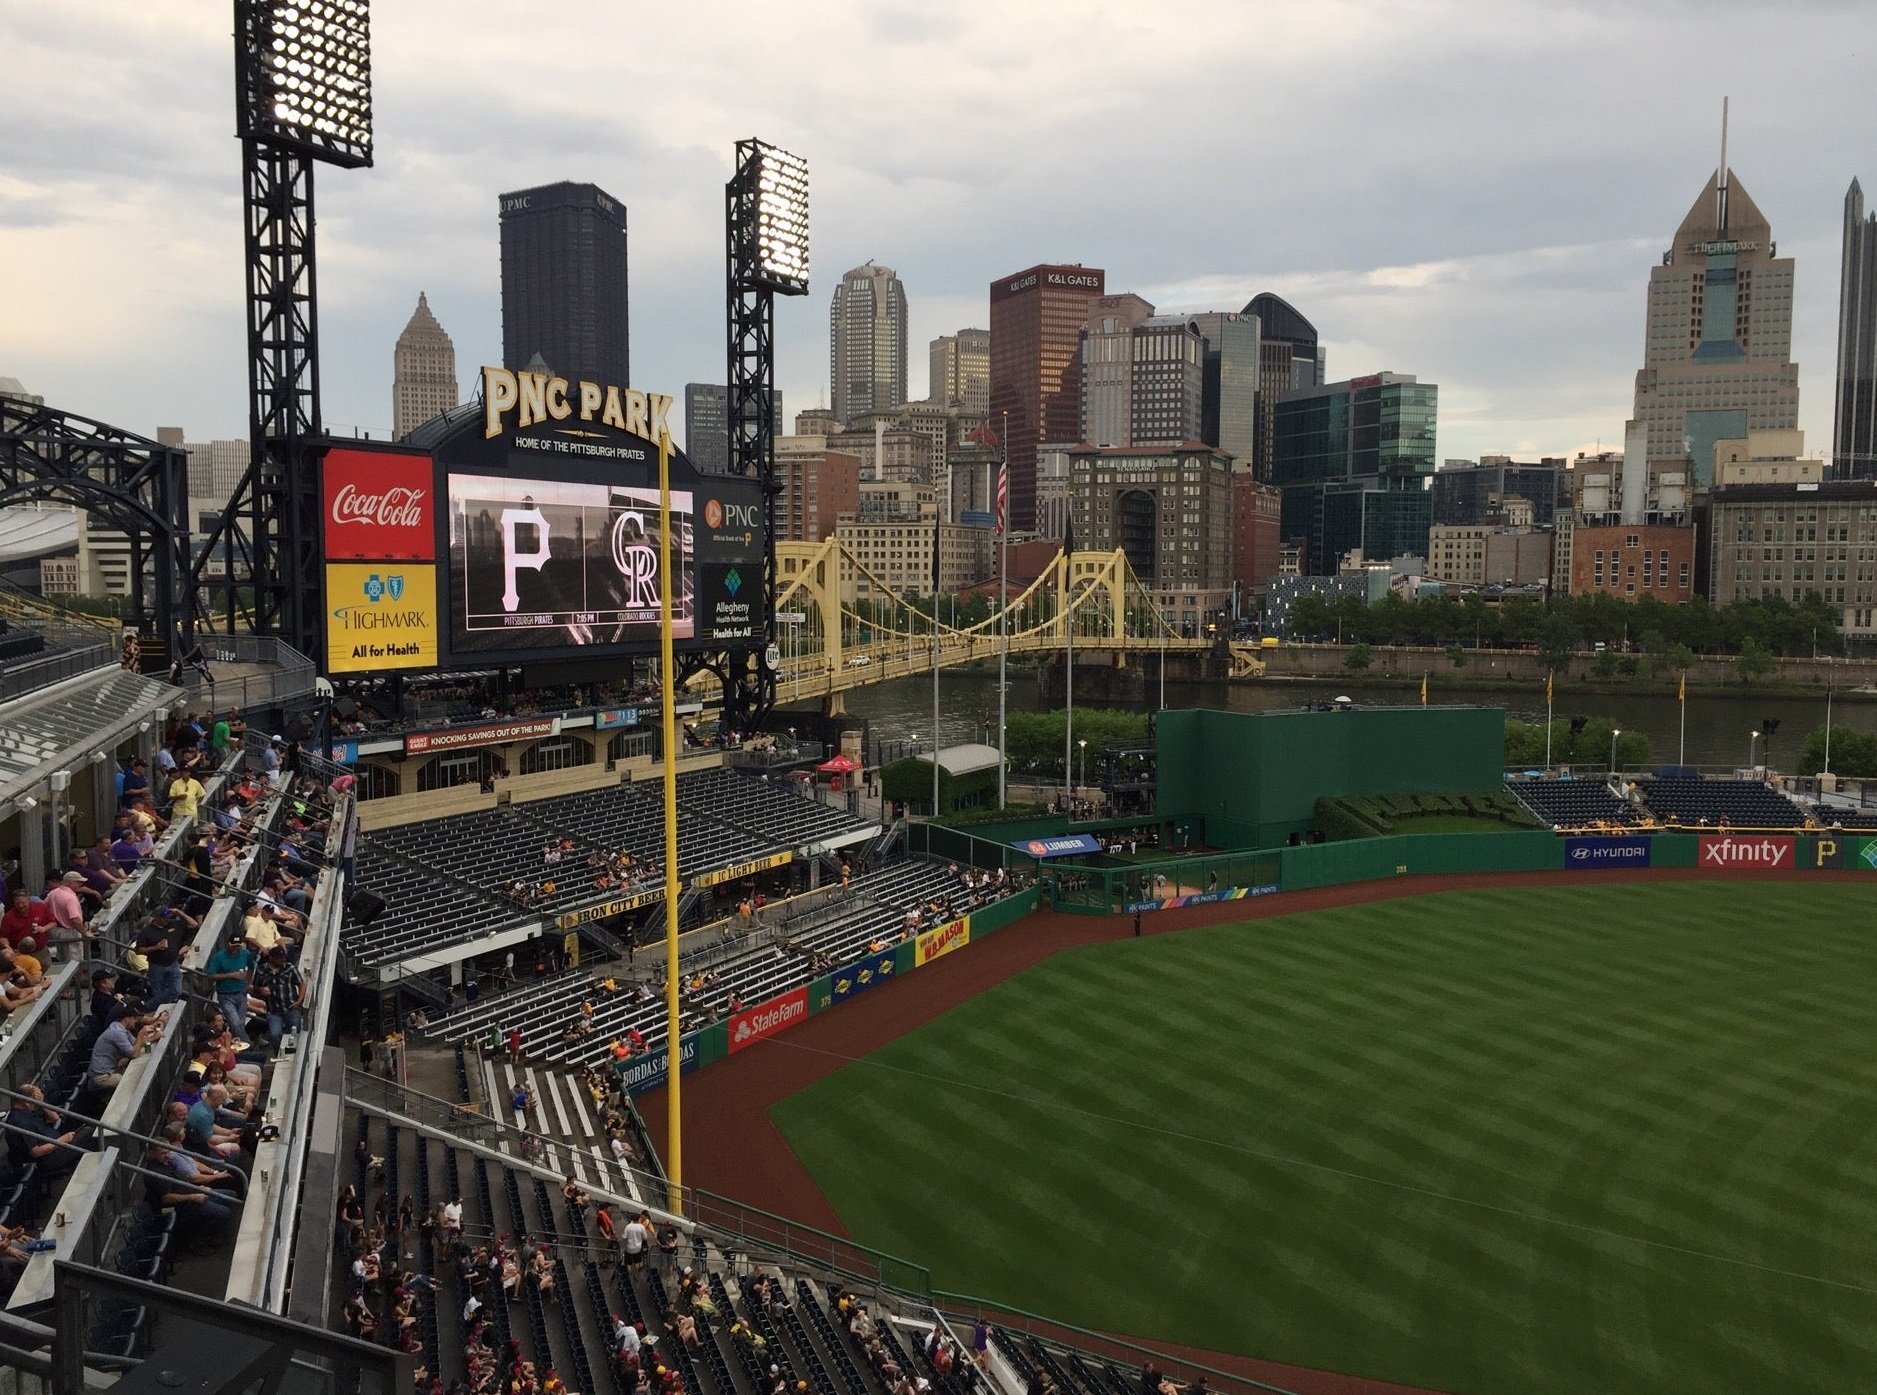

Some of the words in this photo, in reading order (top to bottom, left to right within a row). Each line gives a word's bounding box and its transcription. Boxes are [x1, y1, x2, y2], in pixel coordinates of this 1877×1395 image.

[500, 196, 531, 212] UPMC
[1048, 274, 1066, 284] K&L
[1067, 275, 1099, 287] GATES
[482, 366, 572, 439] PNC
[580, 381, 676, 457] PARK
[515, 437, 540, 449] HOME
[541, 439, 551, 450] OF
[553, 441, 569, 452] THE
[570, 442, 616, 457] PITTSBURGH
[617, 448, 645, 460] PIRATES
[332, 484, 425, 526] Coca-Cola
[723, 504, 759, 527] PNC
[617, 612, 639, 621] COLORADO
[639, 611, 656, 620] ROCKIES
[716, 602, 750, 615] Allegheny
[504, 616, 534, 626] PITTSBURGH
[534, 615, 553, 625] PIRATES
[576, 613, 586, 623] 7:05
[587, 613, 595, 622] PM
[713, 628, 733, 639] Health
[742, 627, 752, 637] All
[352, 645, 367, 658] All
[369, 644, 384, 657] for
[387, 642, 420, 656] Health
[767, 651, 779, 663] Lite
[431, 734, 467, 745] KNOCKING
[468, 730, 495, 741] SAVINGS
[496, 728, 510, 737] OUT
[511, 727, 520, 735] OF
[520, 725, 533, 734] THE
[1045, 839, 1085, 850] LUMBER
[1593, 847, 1646, 858] HYUNDAI
[1705, 839, 1788, 866] xfinity
[1816, 840, 1836, 867] P
[718, 871, 726, 881] IC
[728, 865, 752, 879] LIGHT
[755, 858, 771, 873] BEER
[582, 906, 607, 922] IRON
[609, 899, 635, 915] CITY
[638, 890, 665, 907] BEER
[623, 1058, 658, 1086] BORDAS
[661, 1043, 694, 1070] BODAS
